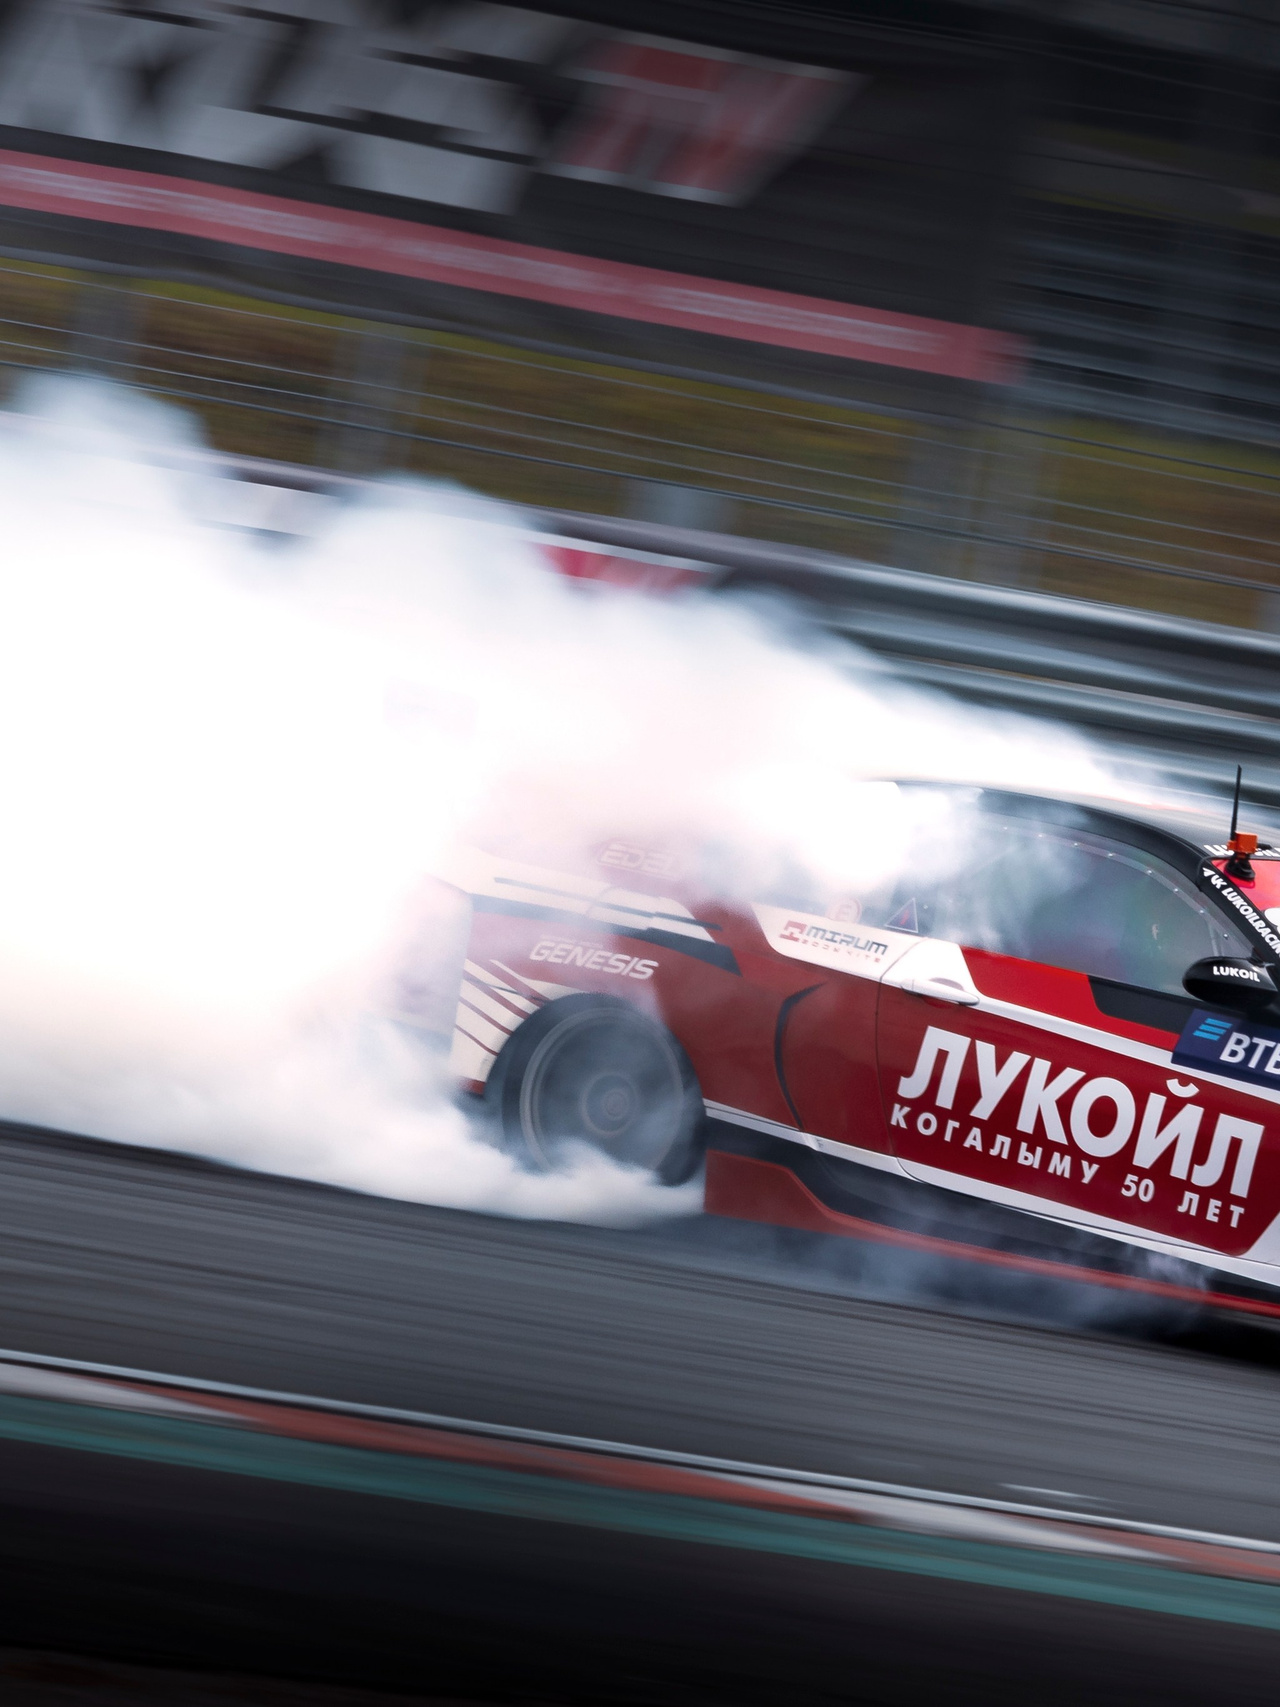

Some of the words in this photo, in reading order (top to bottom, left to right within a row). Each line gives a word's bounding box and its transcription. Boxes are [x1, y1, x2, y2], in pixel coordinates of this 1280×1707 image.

[529, 940, 660, 981] GENESIS
[805, 925, 889, 955] MIRUM
[1213, 965, 1260, 983] LUKOIL
[897, 1025, 1265, 1199] ЛУКОЙЛ
[890, 1103, 1100, 1185] КОГАЛЫМУ
[1121, 1174, 1155, 1203] 50
[1177, 1192, 1246, 1229] ЛЕТ
